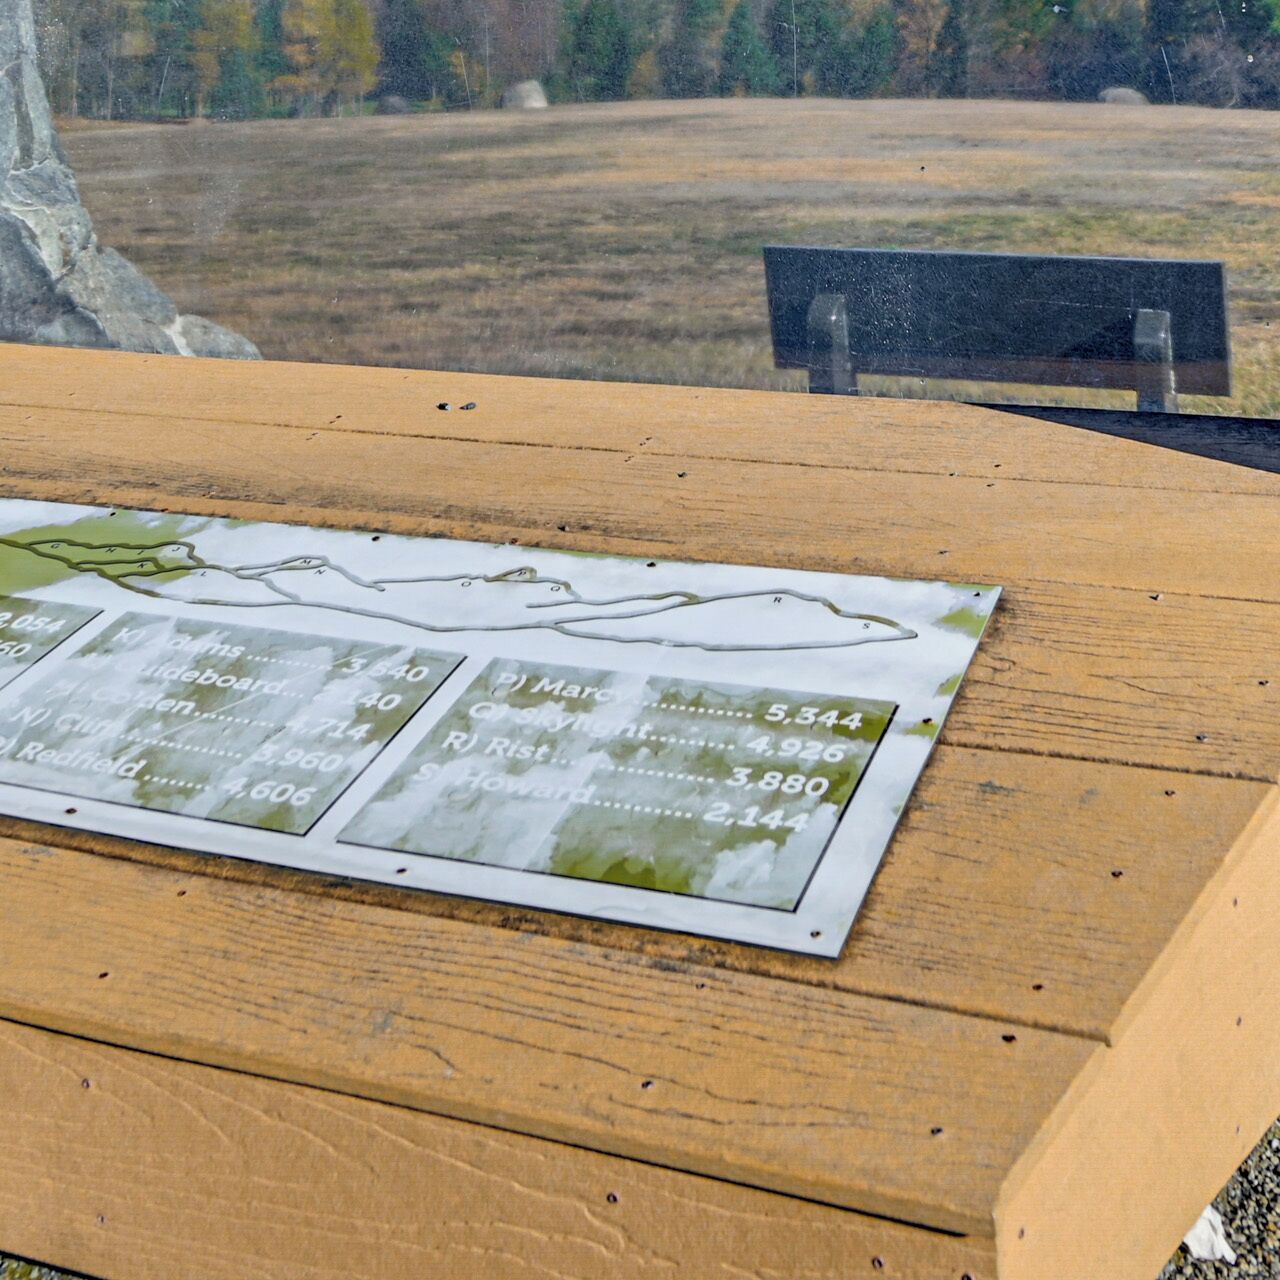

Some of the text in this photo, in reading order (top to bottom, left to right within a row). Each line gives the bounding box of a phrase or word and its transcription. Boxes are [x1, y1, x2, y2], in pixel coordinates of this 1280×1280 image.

[111, 627, 146, 644] K)
[496, 672, 526, 691] P)
[765, 703, 861, 729] 5,344
[8, 706, 51, 726] N)
[251, 743, 343, 771] 3,960
[441, 731, 828, 796] R) Rist 3,880
[746, 735, 847, 762] 4,926
[17, 741, 146, 776] Redfield
[223, 777, 316, 806] 4,606
[454, 769, 596, 803] Howard
[703, 801, 807, 831] 2,144
